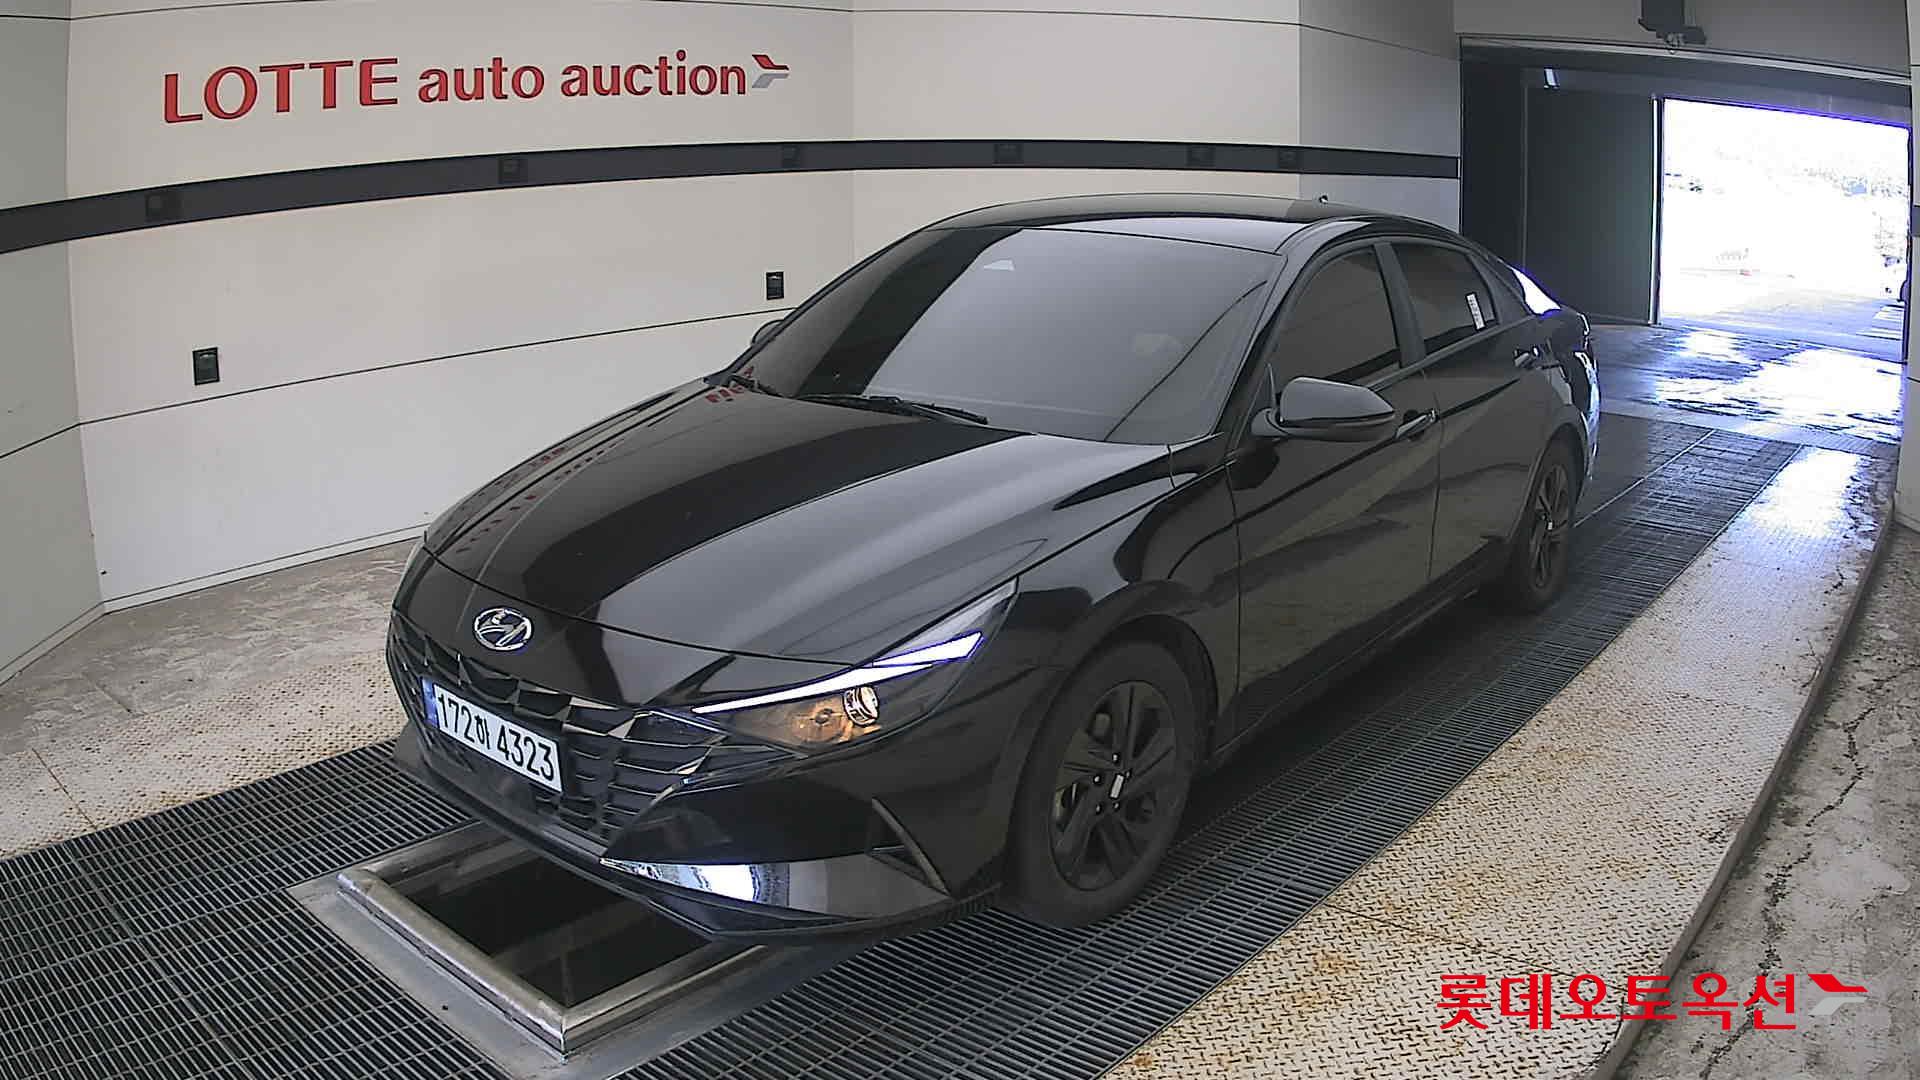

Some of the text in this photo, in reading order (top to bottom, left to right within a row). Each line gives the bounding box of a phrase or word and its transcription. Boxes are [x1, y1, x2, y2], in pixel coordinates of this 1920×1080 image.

[163, 49, 746, 124] LOTTE auto auction
[496, 724, 555, 782] 4323
